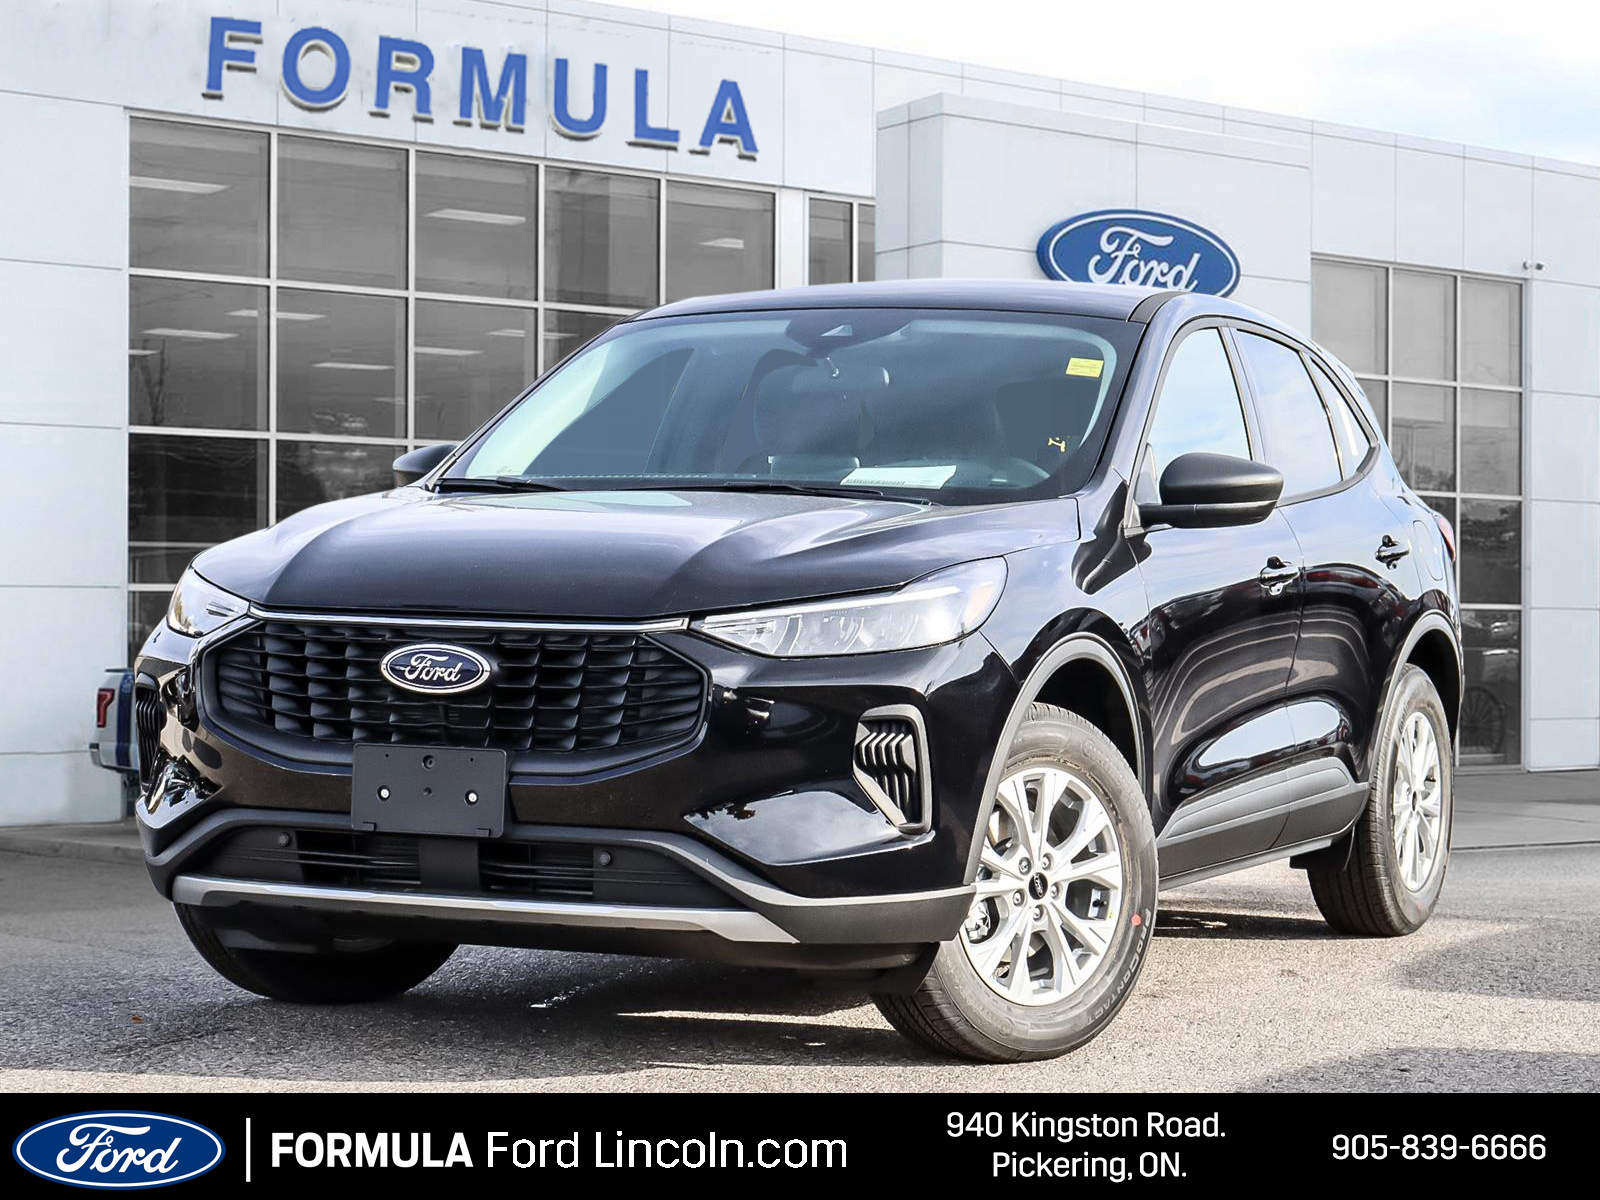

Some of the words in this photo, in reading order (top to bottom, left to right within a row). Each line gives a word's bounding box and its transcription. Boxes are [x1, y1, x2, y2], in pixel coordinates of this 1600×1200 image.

[203, 17, 759, 159] FORMULA
[1087, 226, 1202, 292] Ford
[404, 653, 463, 682] Ford
